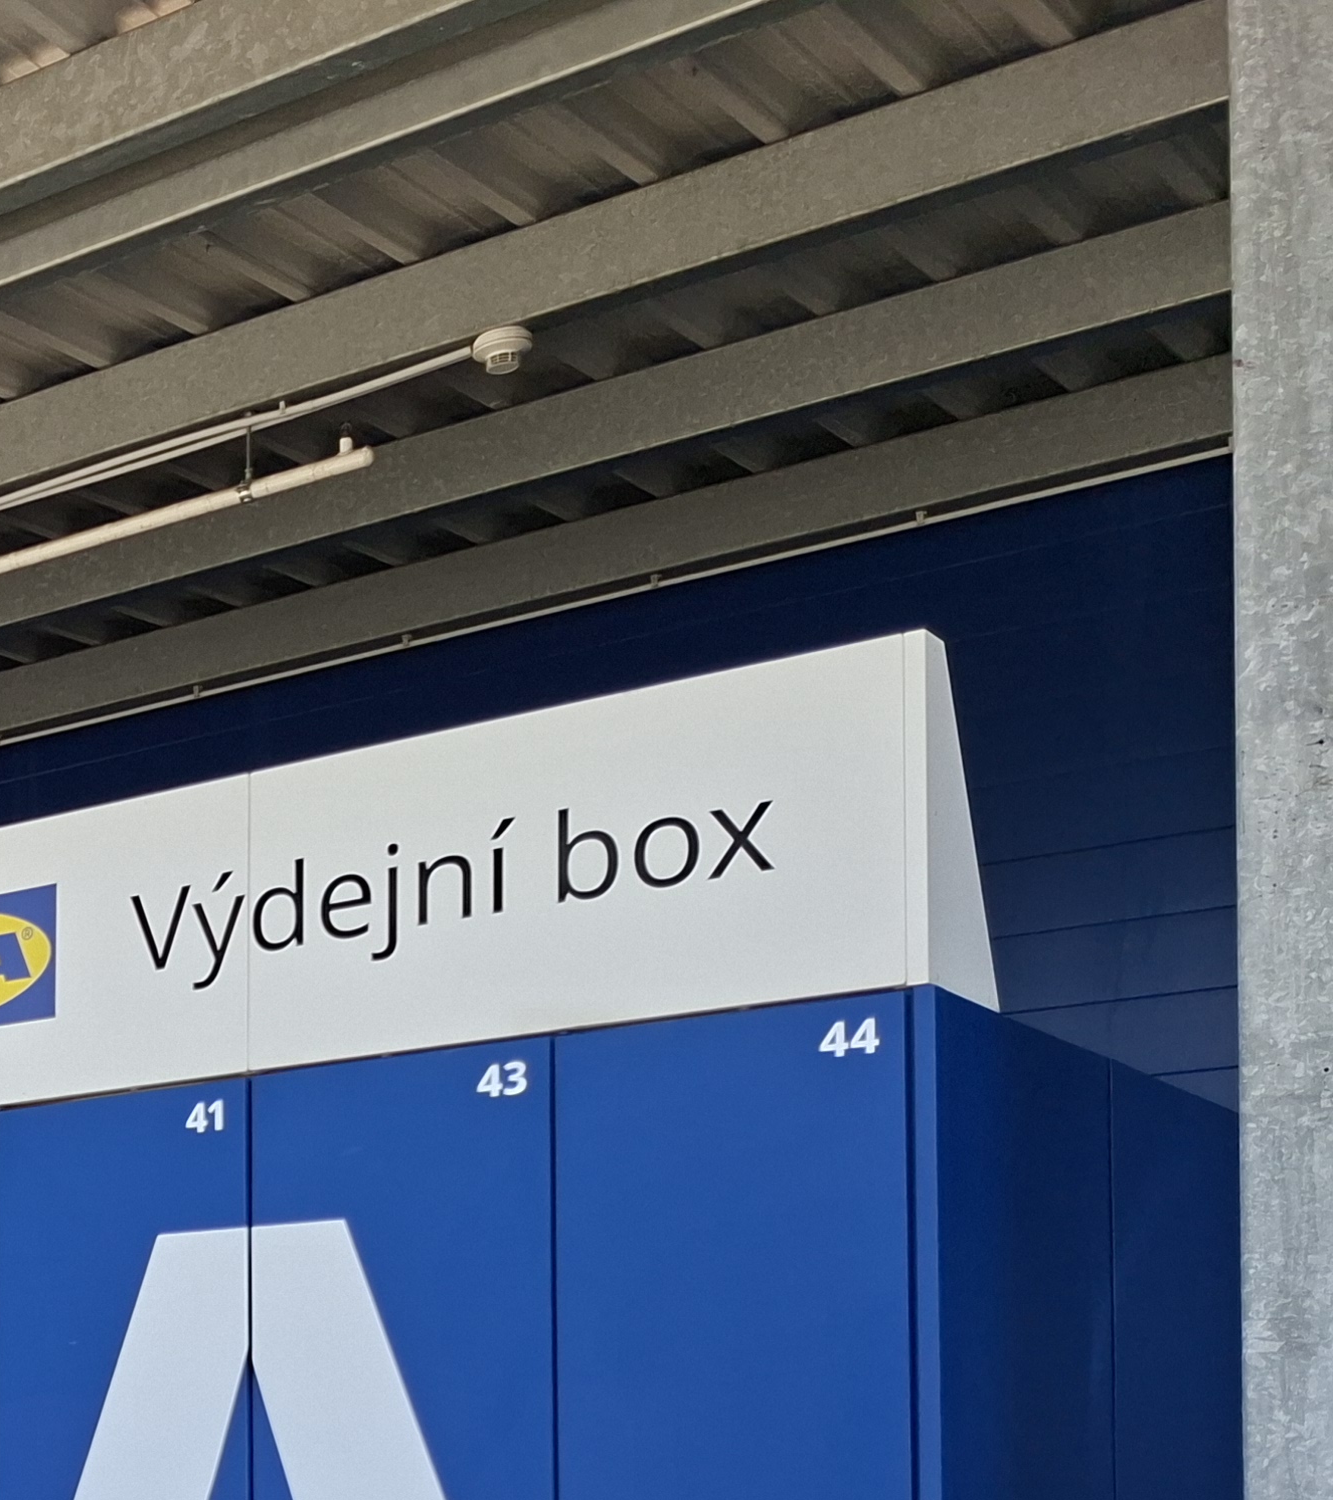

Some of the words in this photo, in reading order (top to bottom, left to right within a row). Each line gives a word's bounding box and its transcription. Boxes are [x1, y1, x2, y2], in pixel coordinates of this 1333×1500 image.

[130, 816, 517, 990] Výdejní
[559, 801, 773, 902] box
[820, 1018, 879, 1057] 44
[477, 1061, 527, 1097] 43
[186, 1100, 223, 1132] 41
